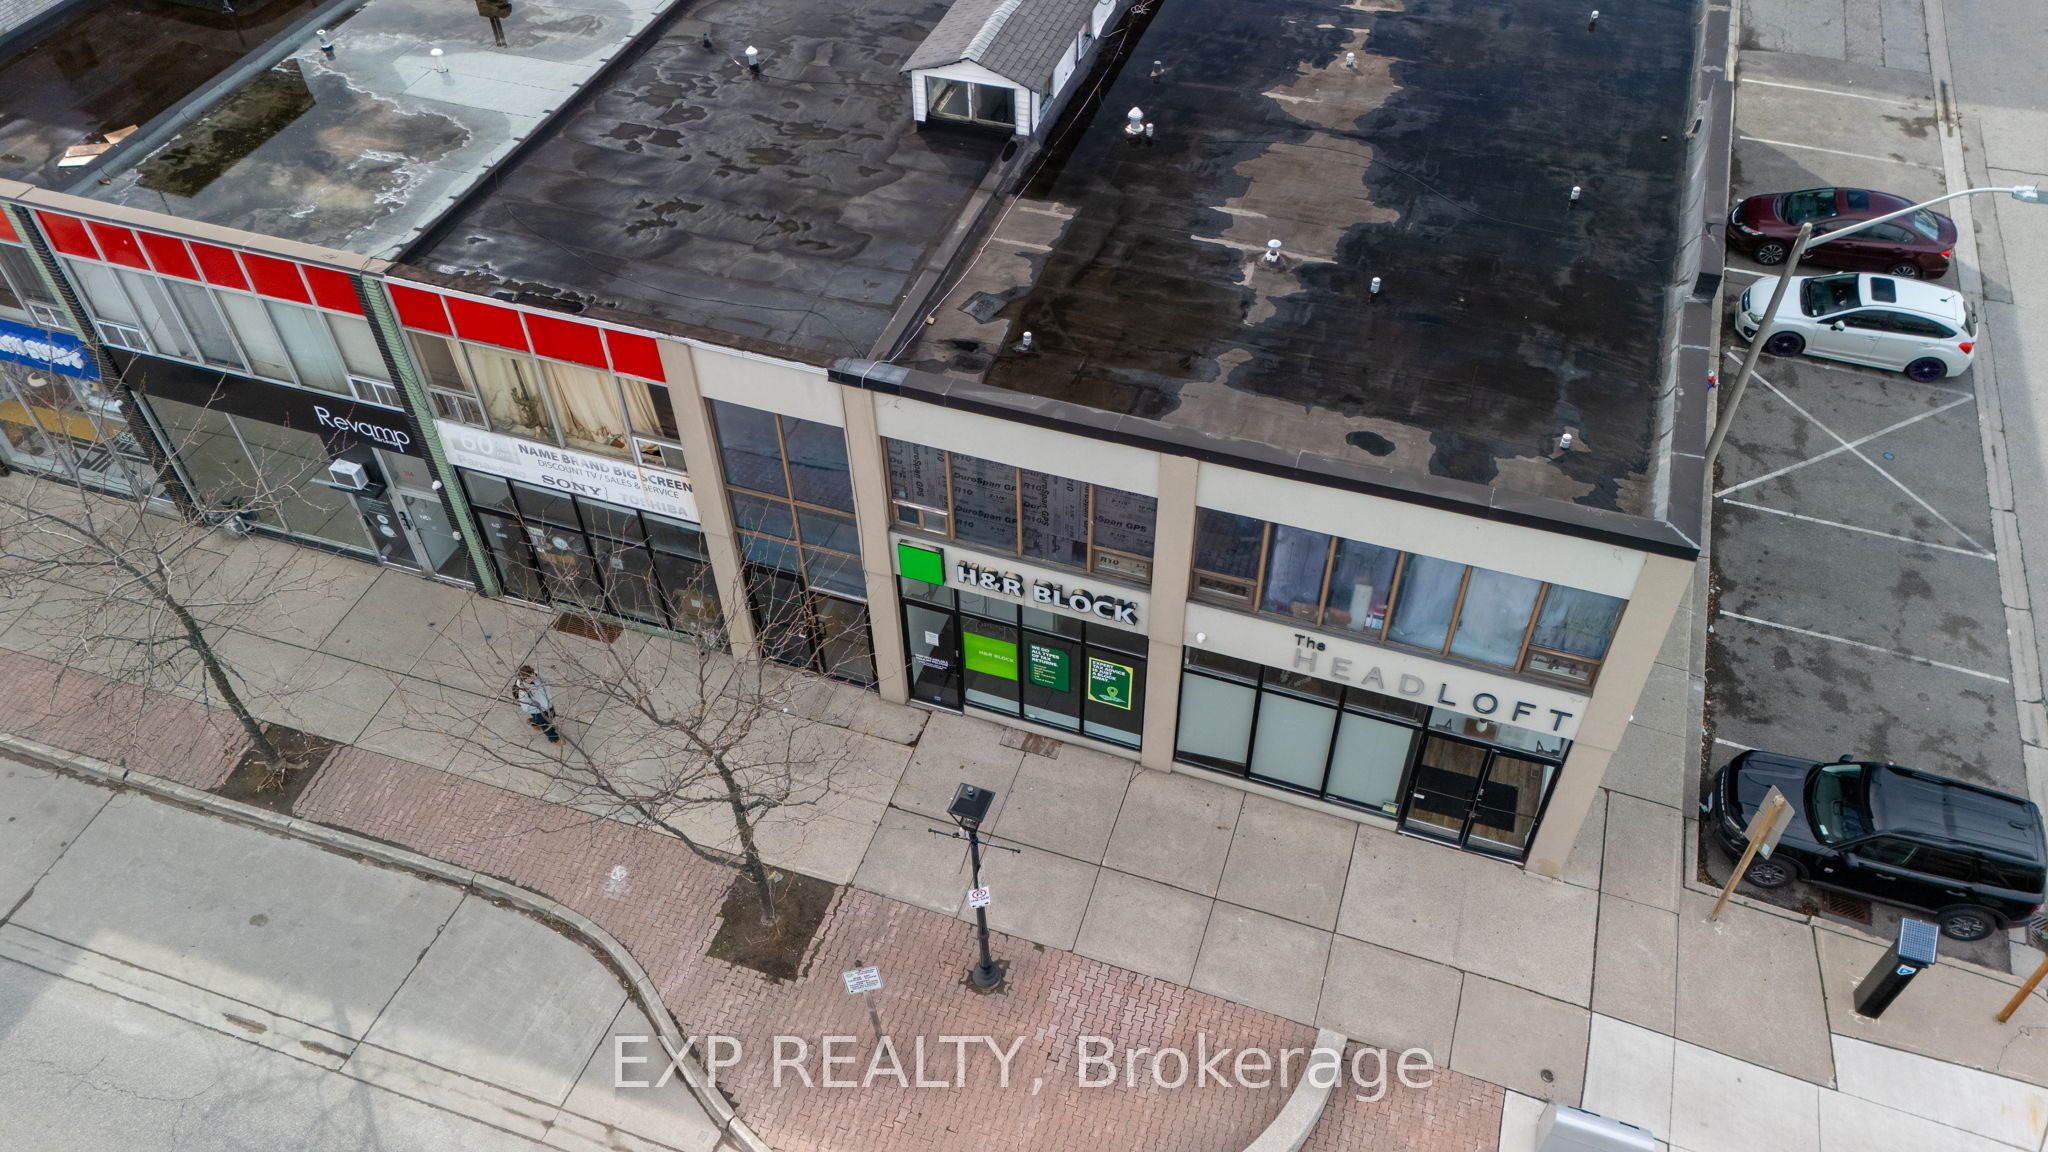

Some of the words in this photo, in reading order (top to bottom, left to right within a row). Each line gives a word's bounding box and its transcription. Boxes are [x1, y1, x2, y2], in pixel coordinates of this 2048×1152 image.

[314, 405, 410, 453] Revamp
[518, 444, 560, 461] NAME
[561, 454, 609, 473] BRAND
[614, 466, 637, 480] BIG
[640, 472, 693, 492] SCREEN
[537, 460, 584, 476] DISCOUNT
[586, 471, 597, 480] TV
[604, 475, 632, 487] SALES
[643, 484, 680, 499] SERVICE
[541, 474, 604, 496] SONY
[953, 472, 1001, 489] DuroSpan
[619, 493, 688, 517] TOSHIBA
[955, 505, 1001, 521] DuroSpan
[1004, 516, 1017, 524] GP
[1126, 522, 1147, 533] GPS
[957, 560, 1024, 597] H&R
[1033, 579, 1138, 626] BLOCK
[1294, 633, 1326, 651] The
[1293, 650, 1425, 697] HEAD
[1437, 683, 1573, 732] LOFT
